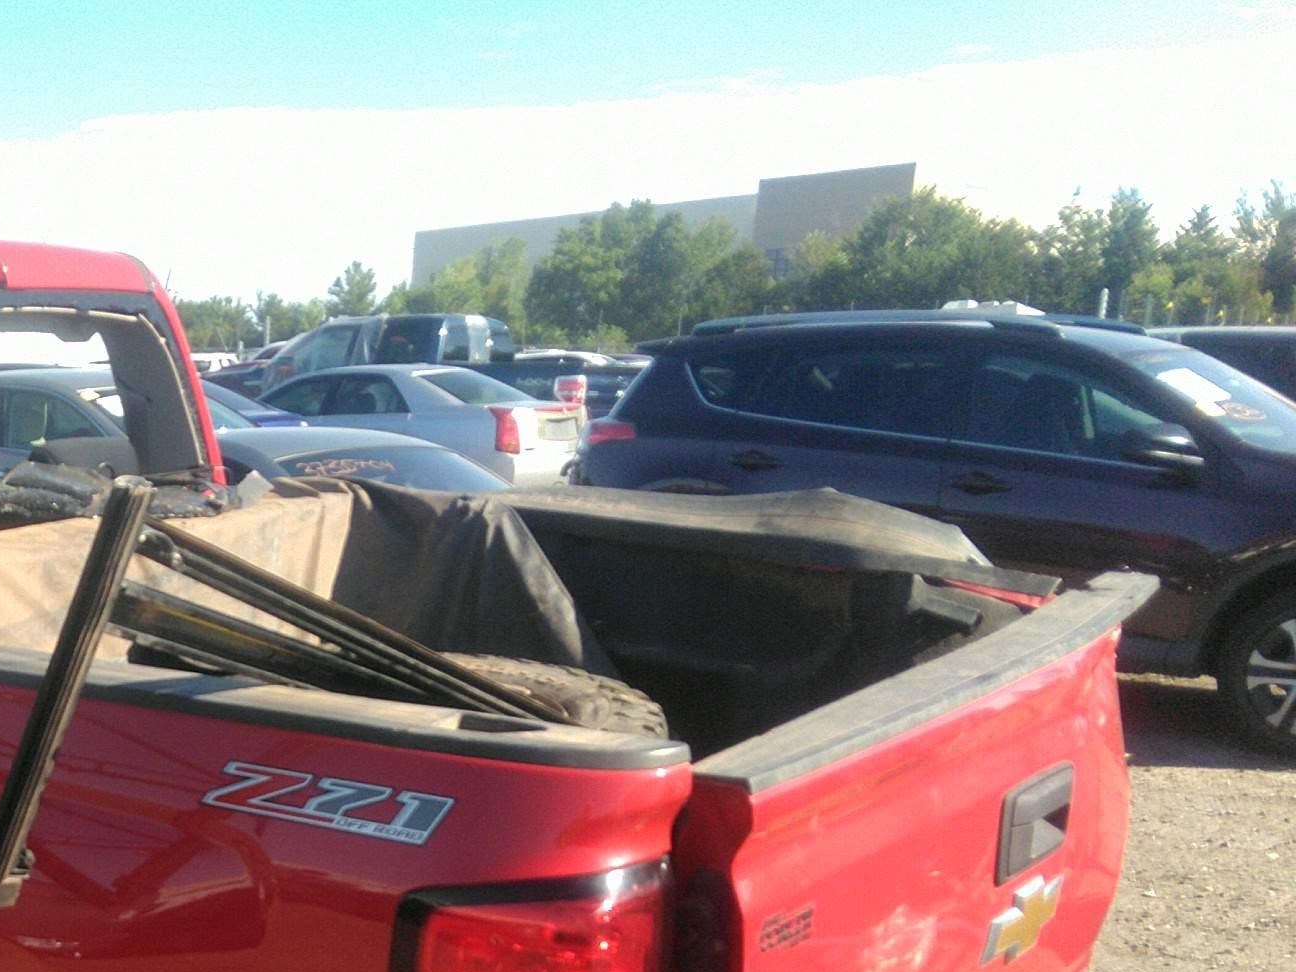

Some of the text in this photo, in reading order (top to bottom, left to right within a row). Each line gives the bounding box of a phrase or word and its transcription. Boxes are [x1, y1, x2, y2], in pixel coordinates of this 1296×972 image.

[202, 760, 454, 837] Z71
[335, 817, 424, 841] OFF ROAD
